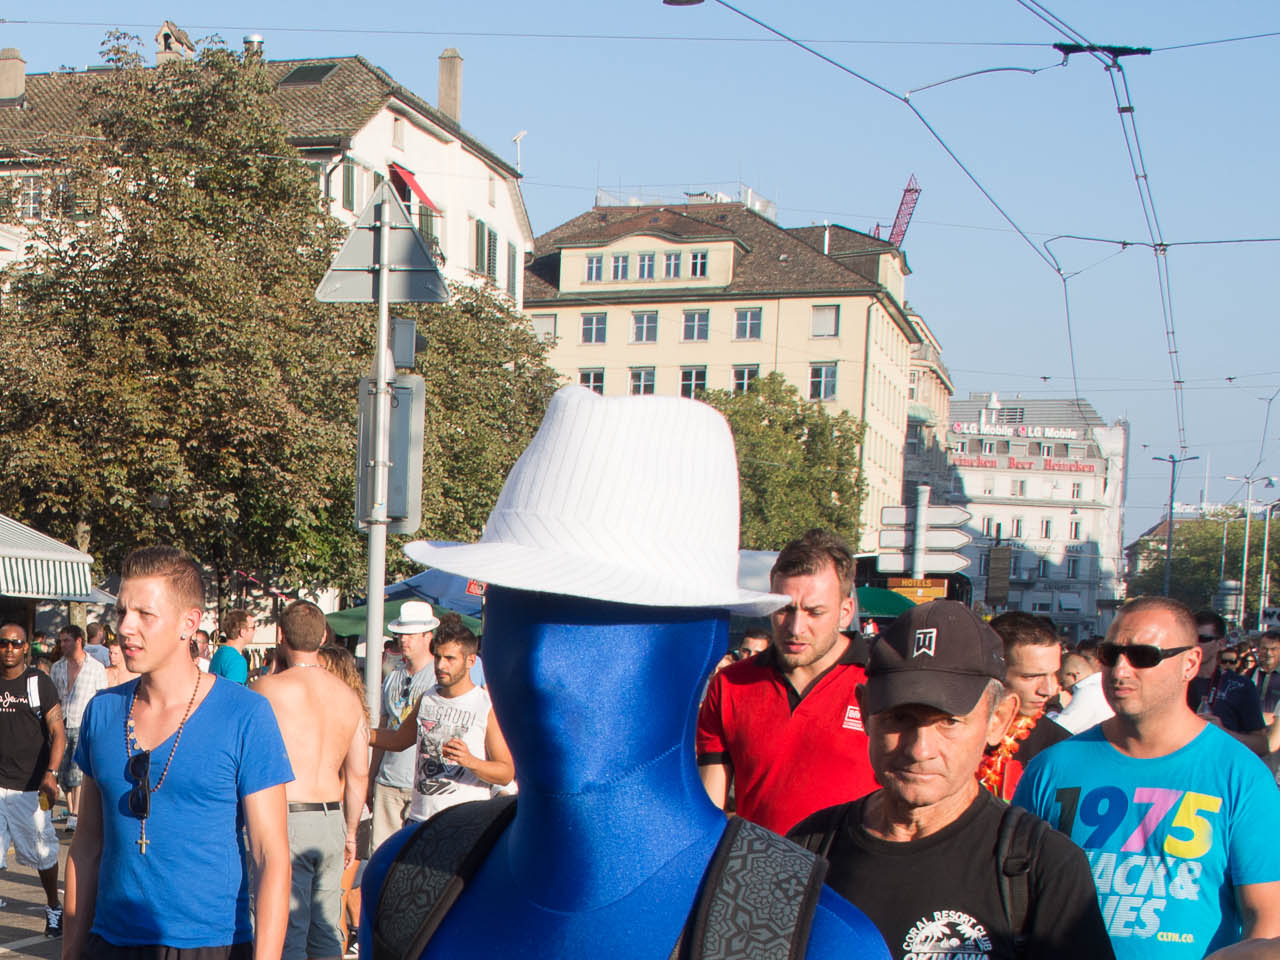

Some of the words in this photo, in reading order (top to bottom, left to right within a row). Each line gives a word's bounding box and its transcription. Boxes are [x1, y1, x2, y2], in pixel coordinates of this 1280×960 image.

[980, 424, 1014, 437] Mobile
[1028, 425, 1042, 438] LG
[1044, 427, 1078, 440] Mobile
[952, 455, 998, 469] eineken
[1007, 456, 1035, 470] Beer
[1043, 457, 1096, 473] Heineken
[901, 578, 933, 587] HOTELS
[1055, 785, 1223, 860] 1975
[902, 916, 932, 951] CORAL
[933, 910, 978, 928] RESORT
[974, 925, 993, 952] CLUB
